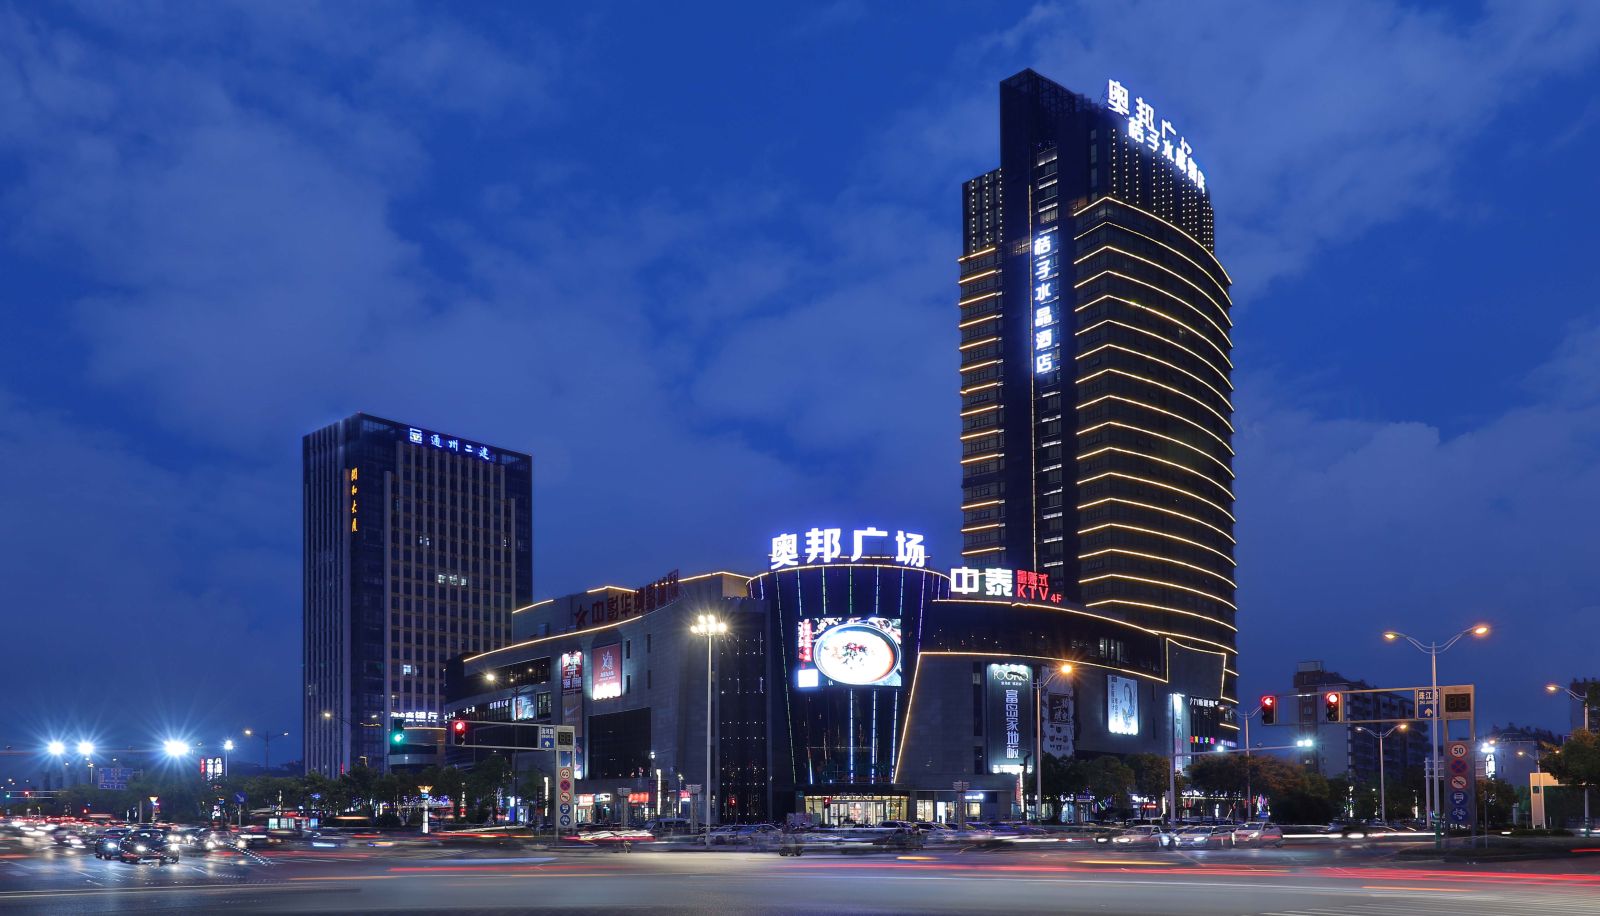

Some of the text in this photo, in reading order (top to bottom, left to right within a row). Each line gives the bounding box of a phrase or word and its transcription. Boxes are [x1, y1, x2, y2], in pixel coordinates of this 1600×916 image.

[1033, 234, 1052, 373] 桔子水晶酒店
[430, 434, 490, 460] 通州二建
[770, 527, 926, 569] 奥邦广场
[950, 566, 1013, 597] 中泰
[1017, 584, 1062, 603] KTV 4F
[1453, 747, 1464, 755] 50
